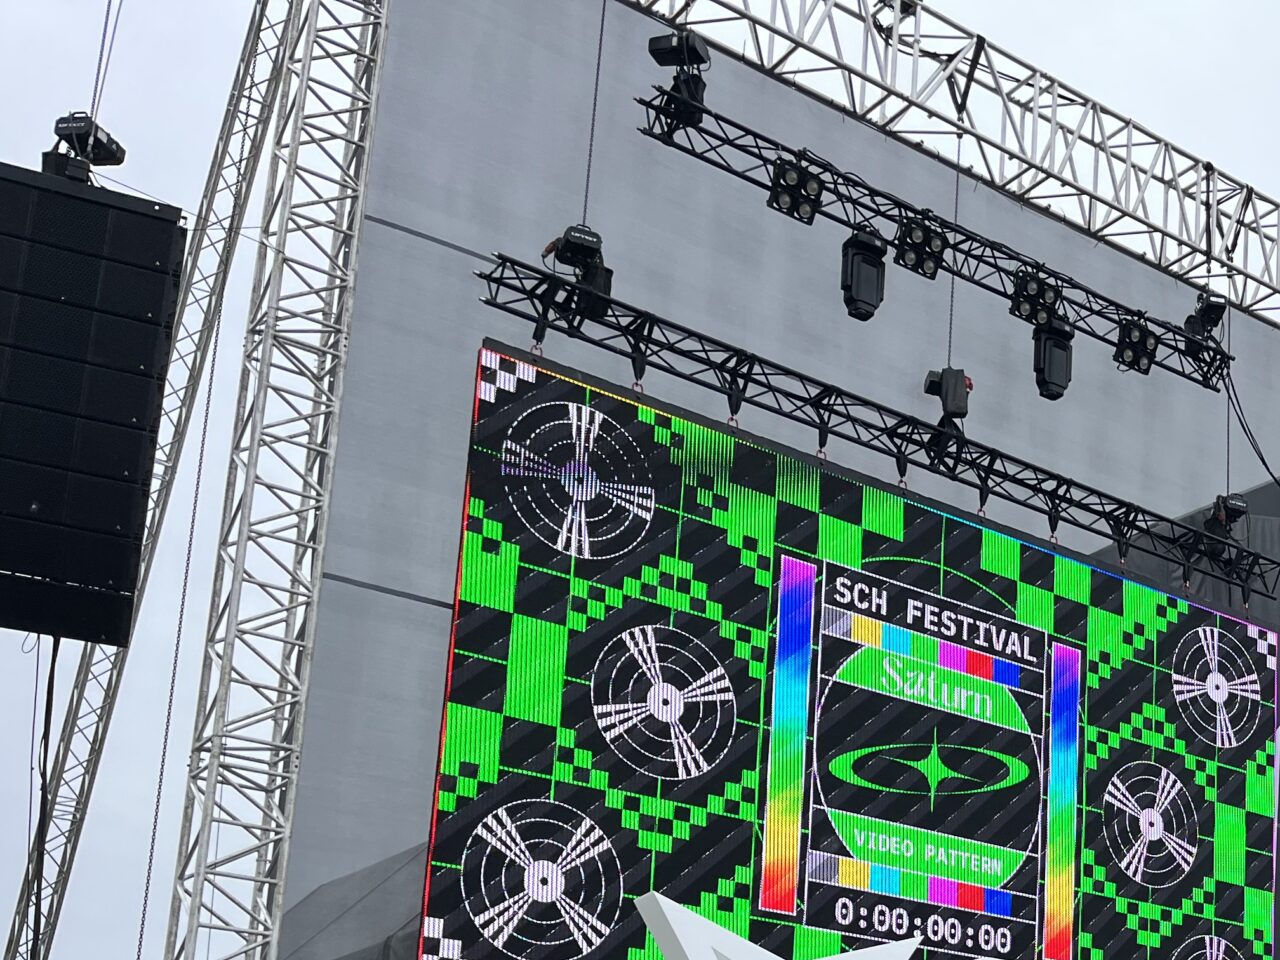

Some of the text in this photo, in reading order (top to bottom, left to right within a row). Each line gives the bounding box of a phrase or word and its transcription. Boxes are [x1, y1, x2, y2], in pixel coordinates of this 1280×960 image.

[834, 576, 1038, 662] SCH FESTIVAL
[881, 656, 992, 719] Saturn
[854, 827, 1002, 877] VIDEO PATTERN
[834, 898, 1012, 953] 0:00:00:00
